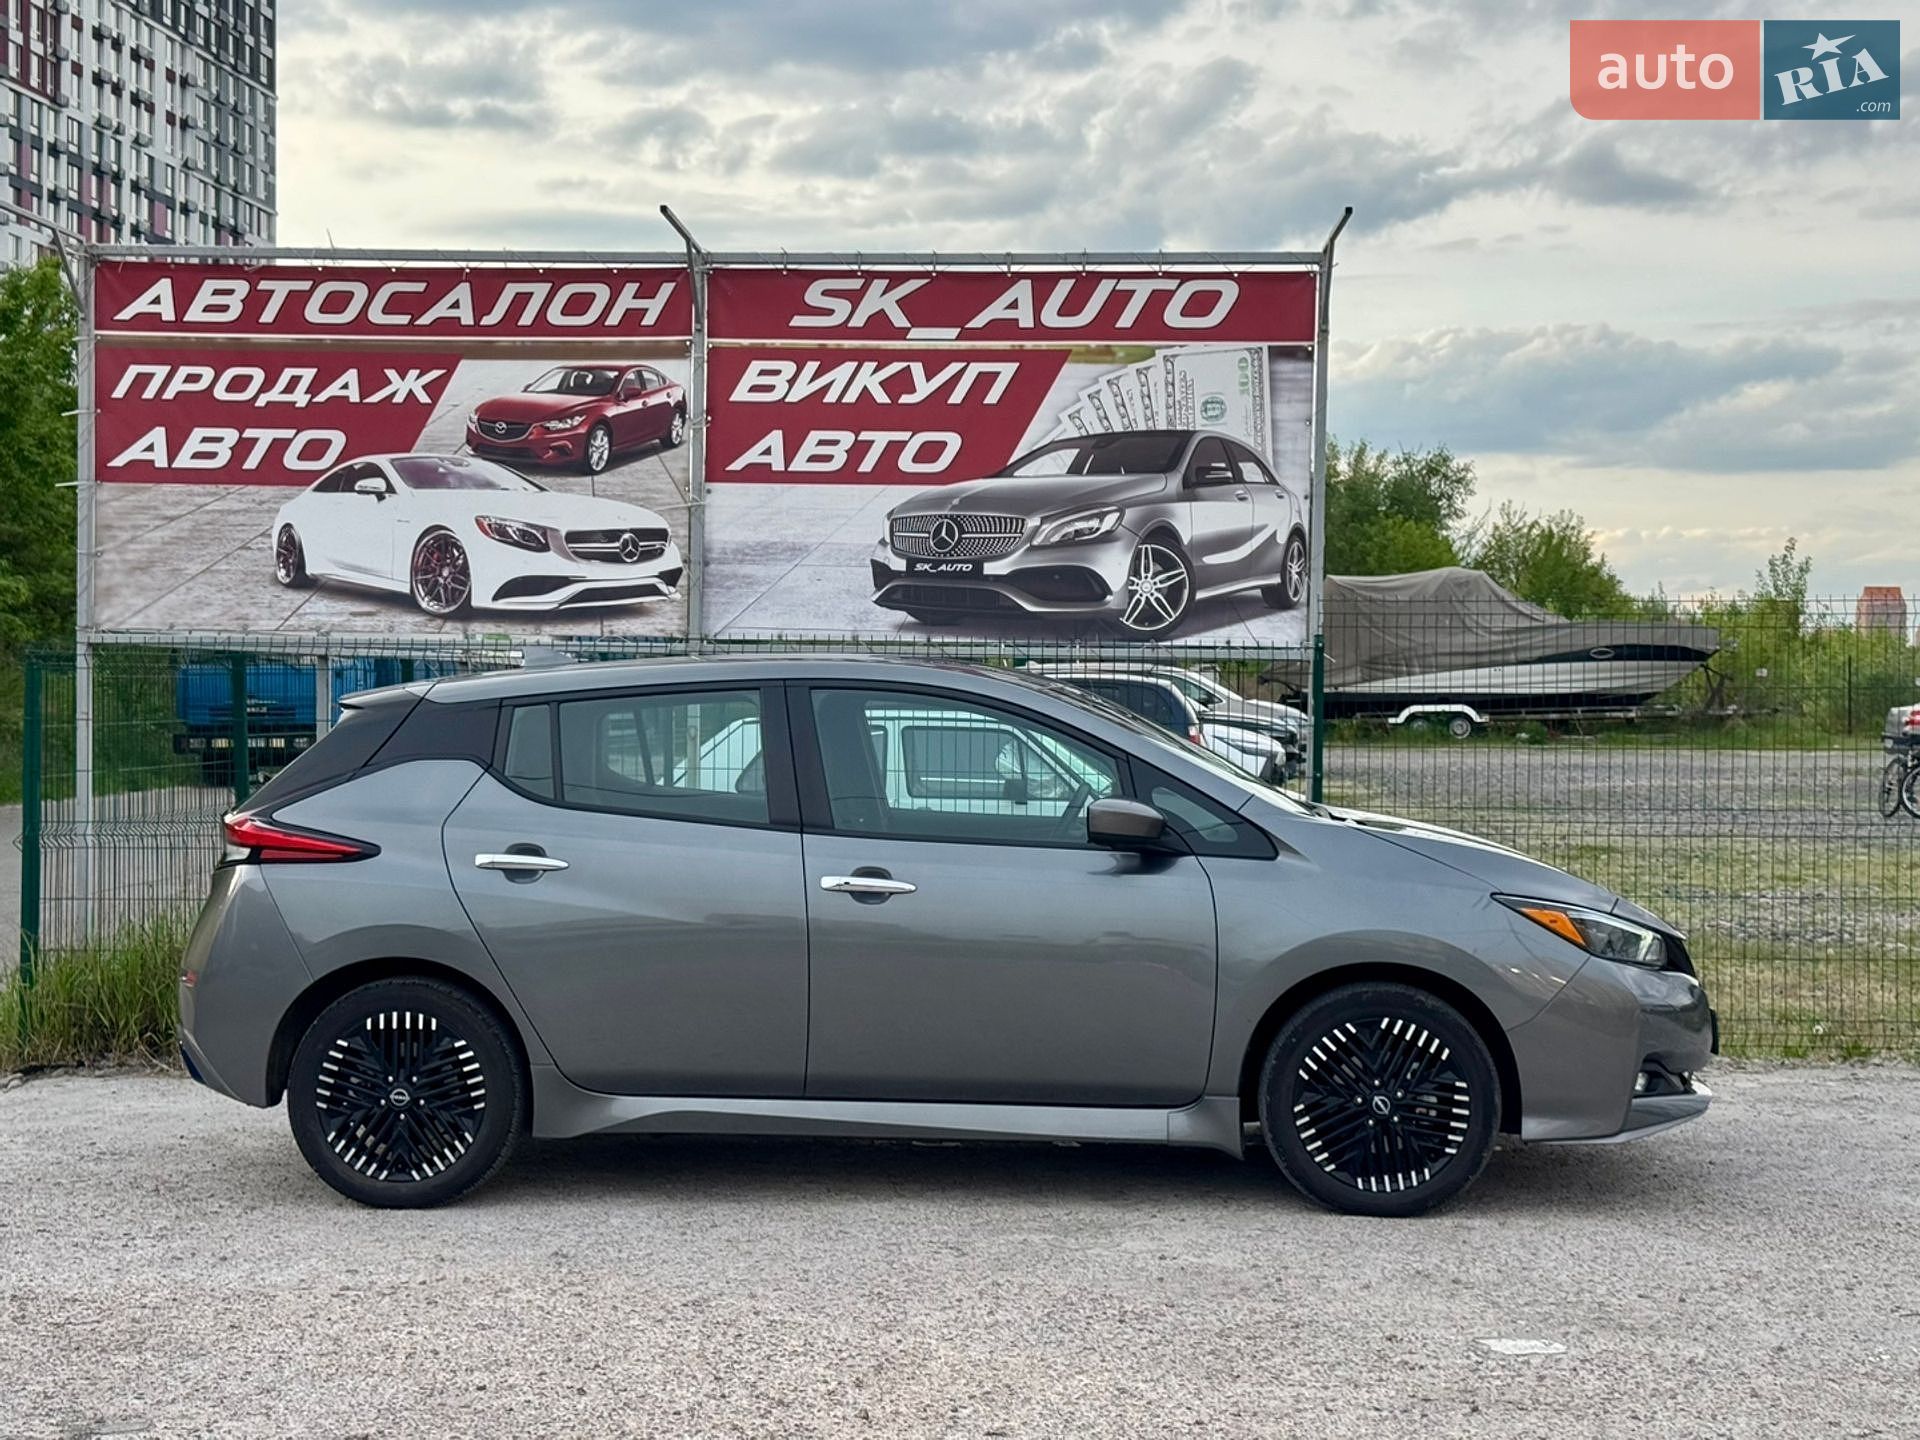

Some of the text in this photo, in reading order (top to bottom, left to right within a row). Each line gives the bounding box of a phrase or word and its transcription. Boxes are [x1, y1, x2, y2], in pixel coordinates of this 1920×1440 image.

[113, 278, 677, 328] АВТОСАЛОН
[789, 278, 1239, 340] SK_AUTO
[111, 364, 447, 408] ПРОДАЖ
[729, 360, 1020, 405] ВИКУП
[107, 426, 347, 471] АВТО
[725, 429, 962, 473] АВТО
[914, 562, 973, 573] SK_AUTO
